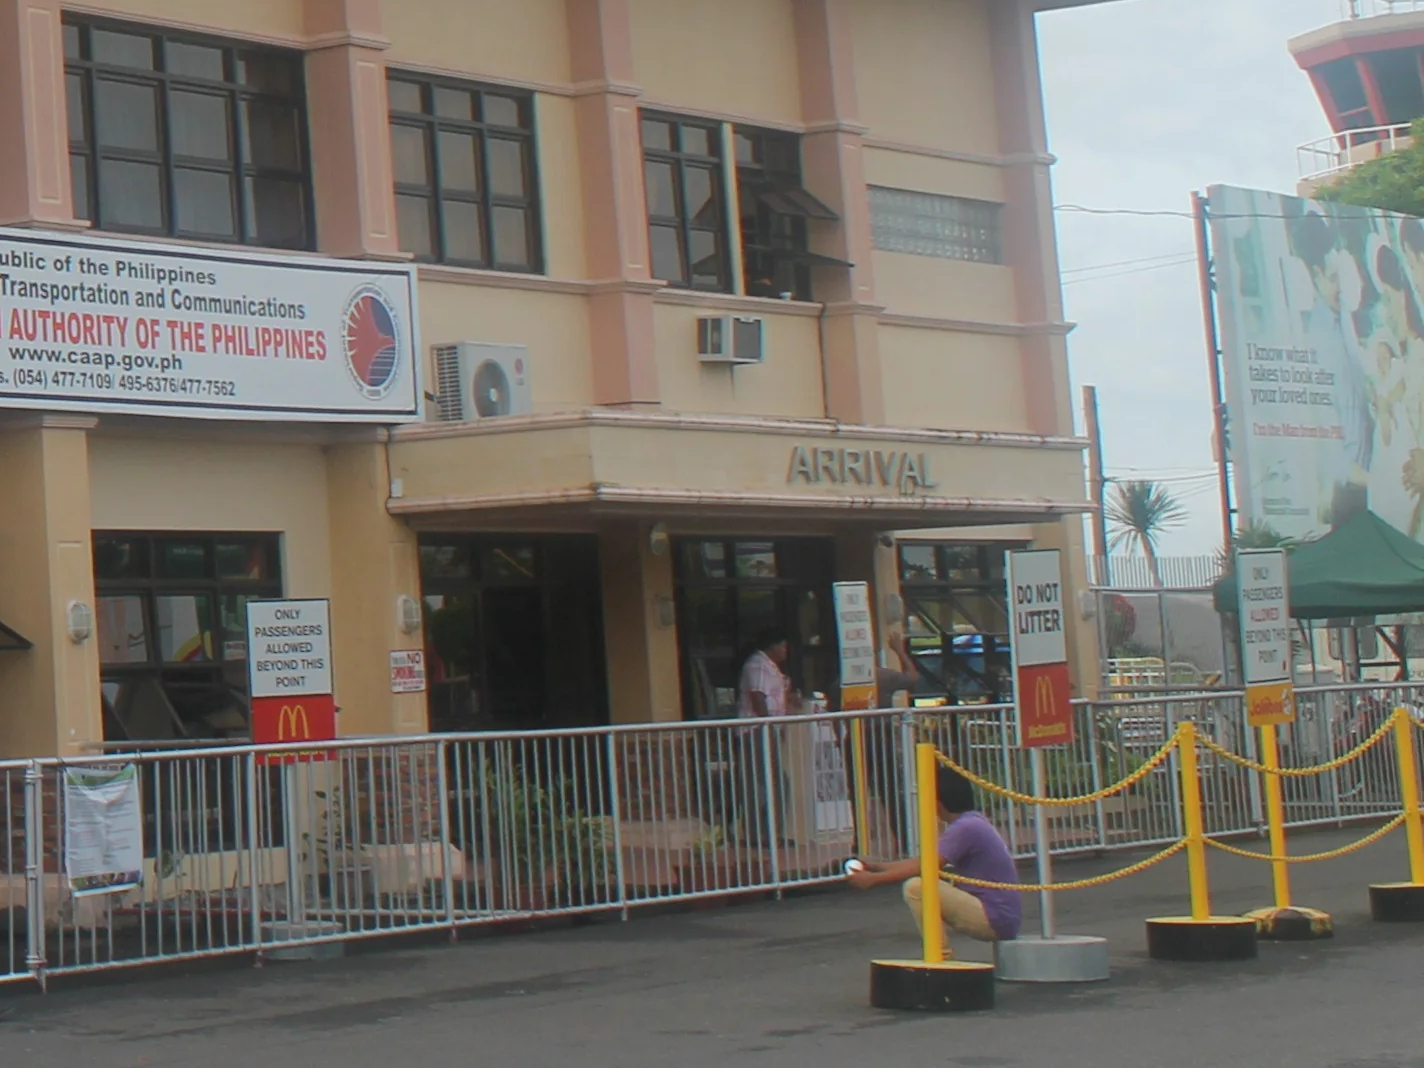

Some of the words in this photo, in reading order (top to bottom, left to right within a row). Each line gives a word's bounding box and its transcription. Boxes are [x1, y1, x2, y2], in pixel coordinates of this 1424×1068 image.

[53, 255, 72, 272] of
[78, 257, 109, 276] the
[116, 260, 217, 285] Philippines
[135, 287, 165, 309] and
[171, 288, 306, 320] Communications
[9, 307, 129, 347] AUTHORITY
[135, 317, 160, 350] OF
[166, 319, 206, 353] THE
[211, 323, 328, 361] PHILIPPINES
[8, 346, 183, 370] www.caap.gov.ph
[1254, 344, 1283, 361] know
[1285, 346, 1310, 363] what
[1311, 346, 1318, 363] it
[13, 367, 47, 389] (054)
[1249, 365, 1279, 383] takes
[1280, 368, 1290, 383] to
[1291, 366, 1313, 384] look
[1314, 368, 1335, 385] after
[1250, 389, 1277, 405] your
[1278, 387, 1307, 405] loved
[1309, 391, 1334, 406] ones.
[786, 445, 939, 489] ARRIVAL
[1017, 585, 1033, 605] DO
[1036, 582, 1059, 603] NOT
[274, 609, 301, 620] ONLY
[1018, 608, 1061, 635] LITTER
[254, 624, 323, 638] PASSENGERS
[265, 642, 313, 654] ALLOWED
[256, 659, 299, 672] BEYOND
[301, 658, 324, 670] THIS
[276, 675, 307, 688] POINT
